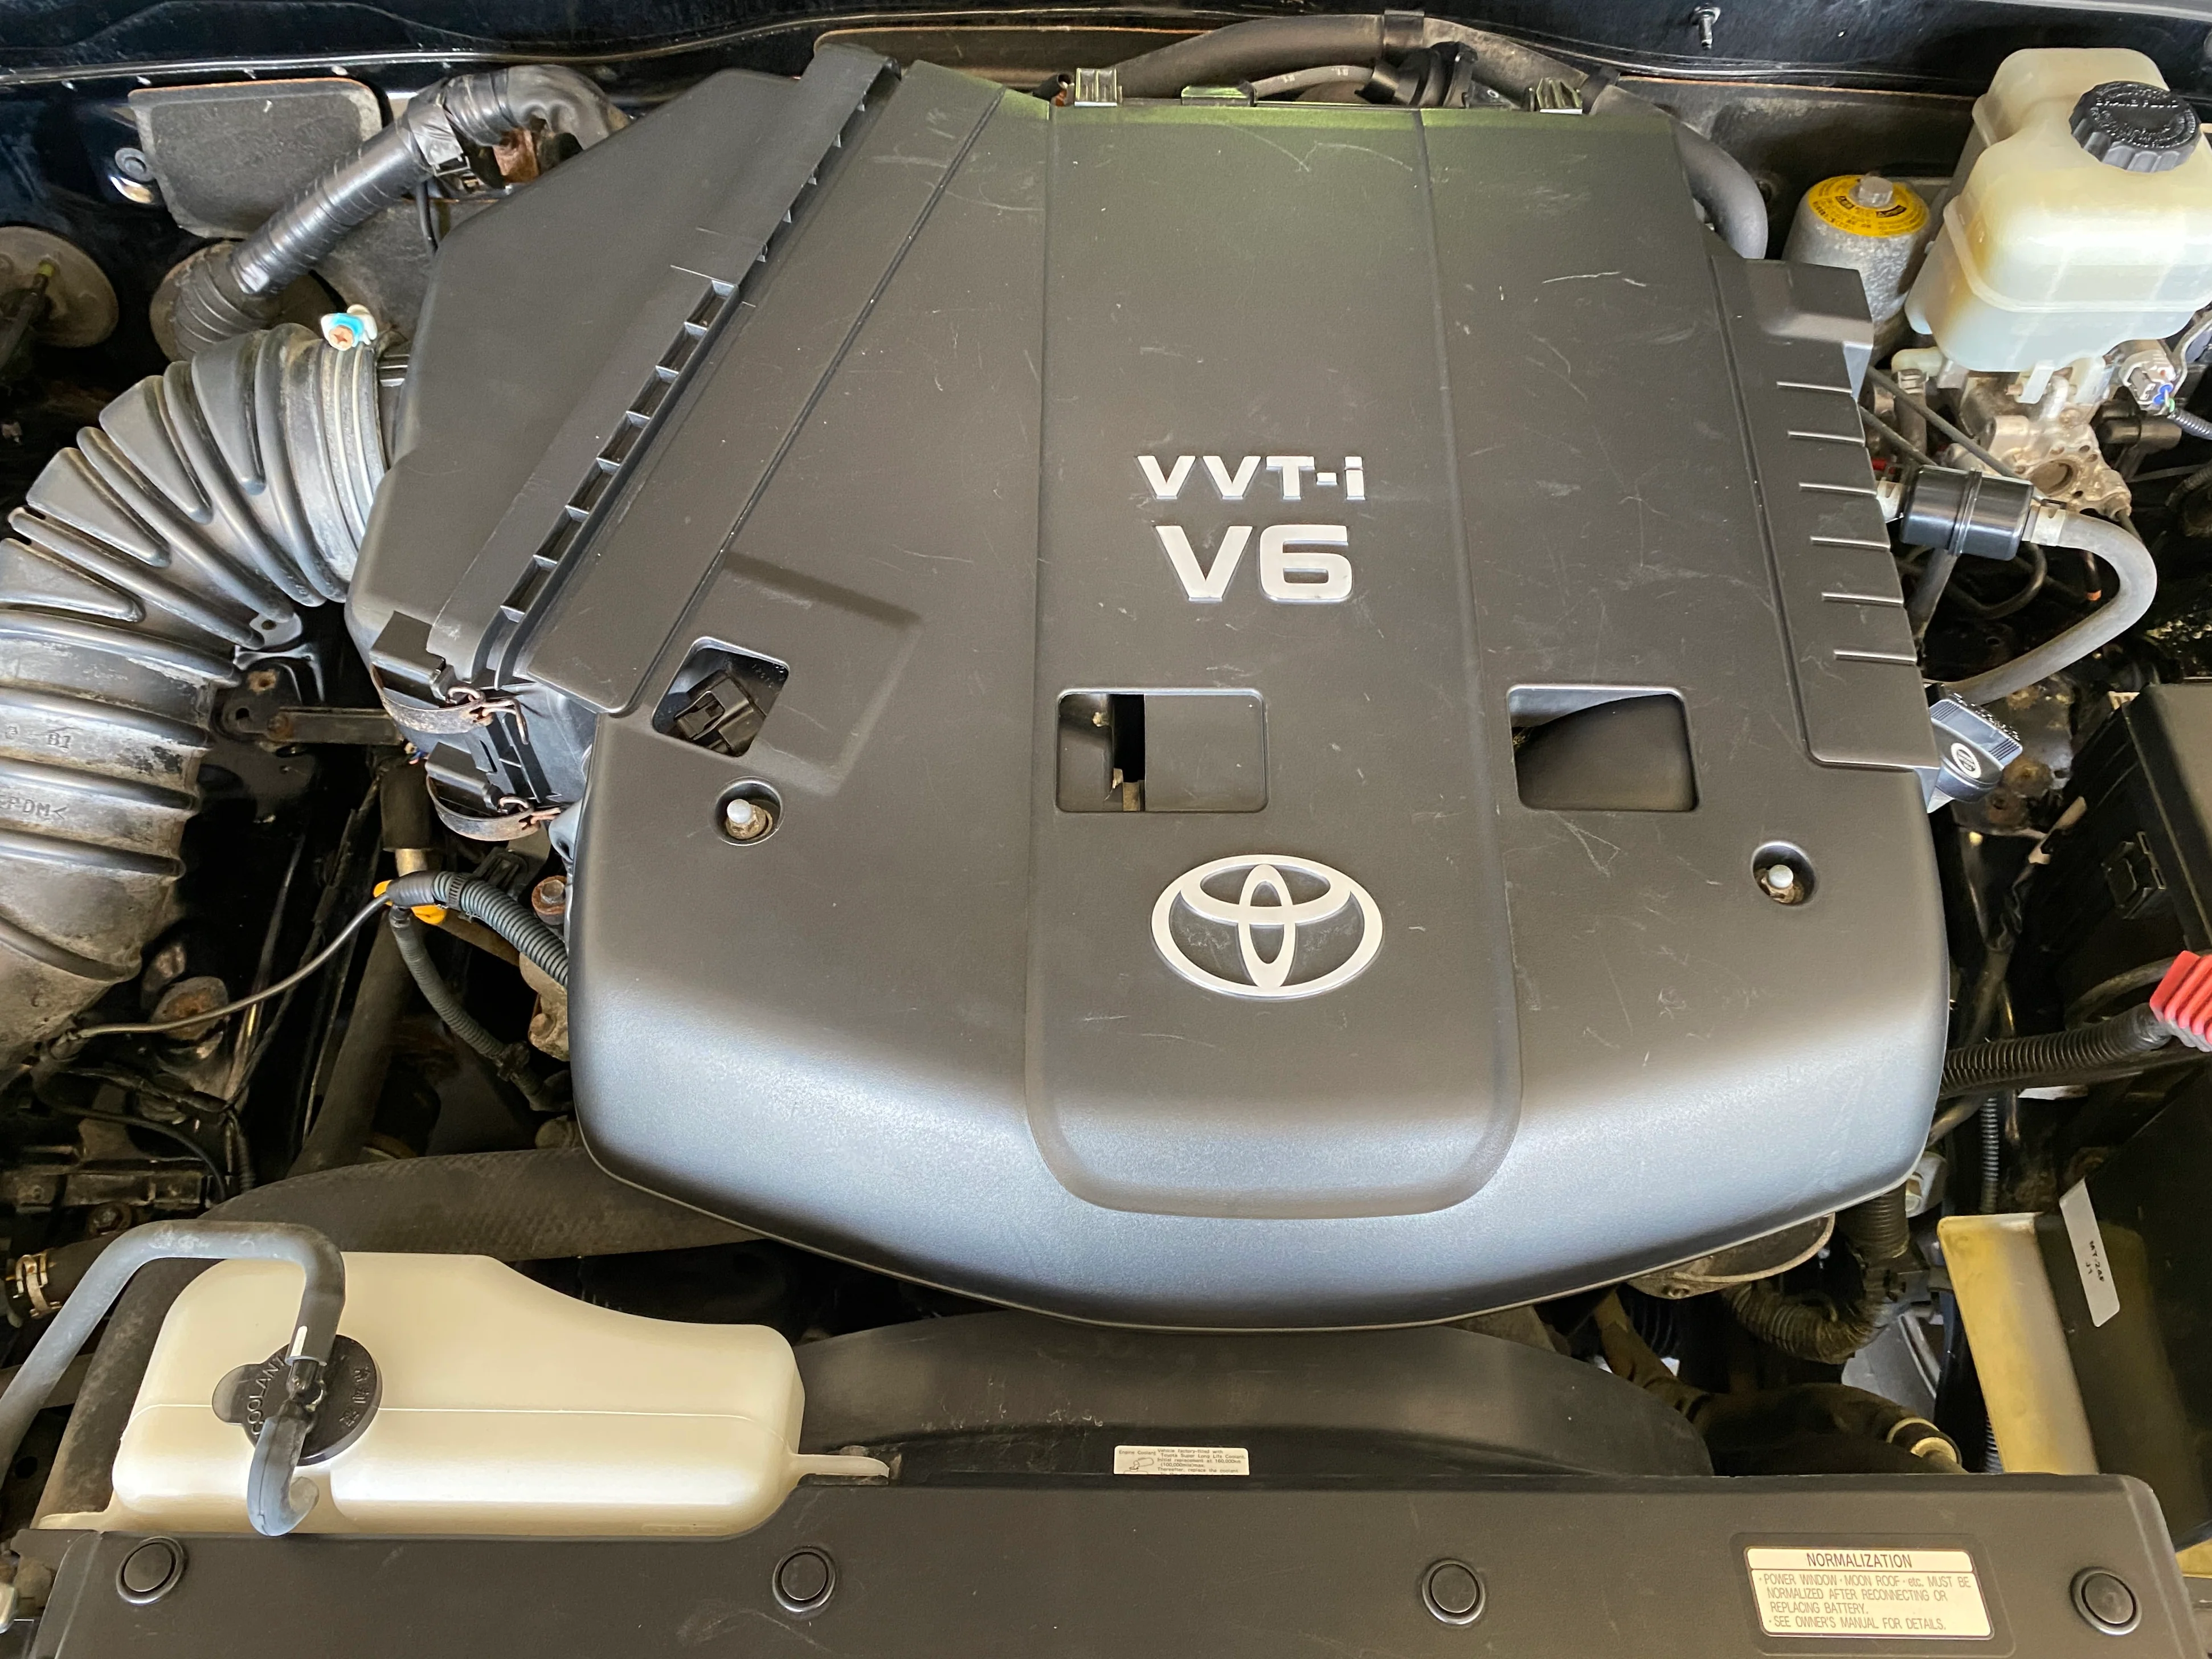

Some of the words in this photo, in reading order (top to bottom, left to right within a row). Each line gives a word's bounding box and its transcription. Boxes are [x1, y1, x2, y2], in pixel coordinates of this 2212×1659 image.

[1136, 456, 1366, 500] VVT-i
[1154, 524, 1353, 604] V6
[1806, 1552, 1912, 1568] NORMALIZATION
[1764, 1574, 1796, 1585] POWER
[1800, 1574, 1837, 1586] WINDOW
[1844, 1575, 1872, 1587] MOON
[1875, 1575, 1900, 1587] ROOF
[1908, 1576, 1924, 1587] etc.
[1927, 1576, 1953, 1588] MUST
[1957, 1576, 1971, 1588] BE
[1767, 1587, 1823, 1599] NORMALIZED
[1829, 1588, 1858, 1600] AFTER
[1861, 1588, 1929, 1601] RECONNECTING
[1933, 1590, 1948, 1601] OR
[1770, 1601, 1820, 1613] REPLACING
[1824, 1602, 1868, 1615] BATTERY.
[1773, 1616, 1792, 1627] SEE
[1795, 1616, 1836, 1628] OWNER'S
[1839, 1617, 1879, 1629] MANUAL
[1882, 1617, 1903, 1629] FOR
[1905, 1618, 1947, 1631] DETAILS.
